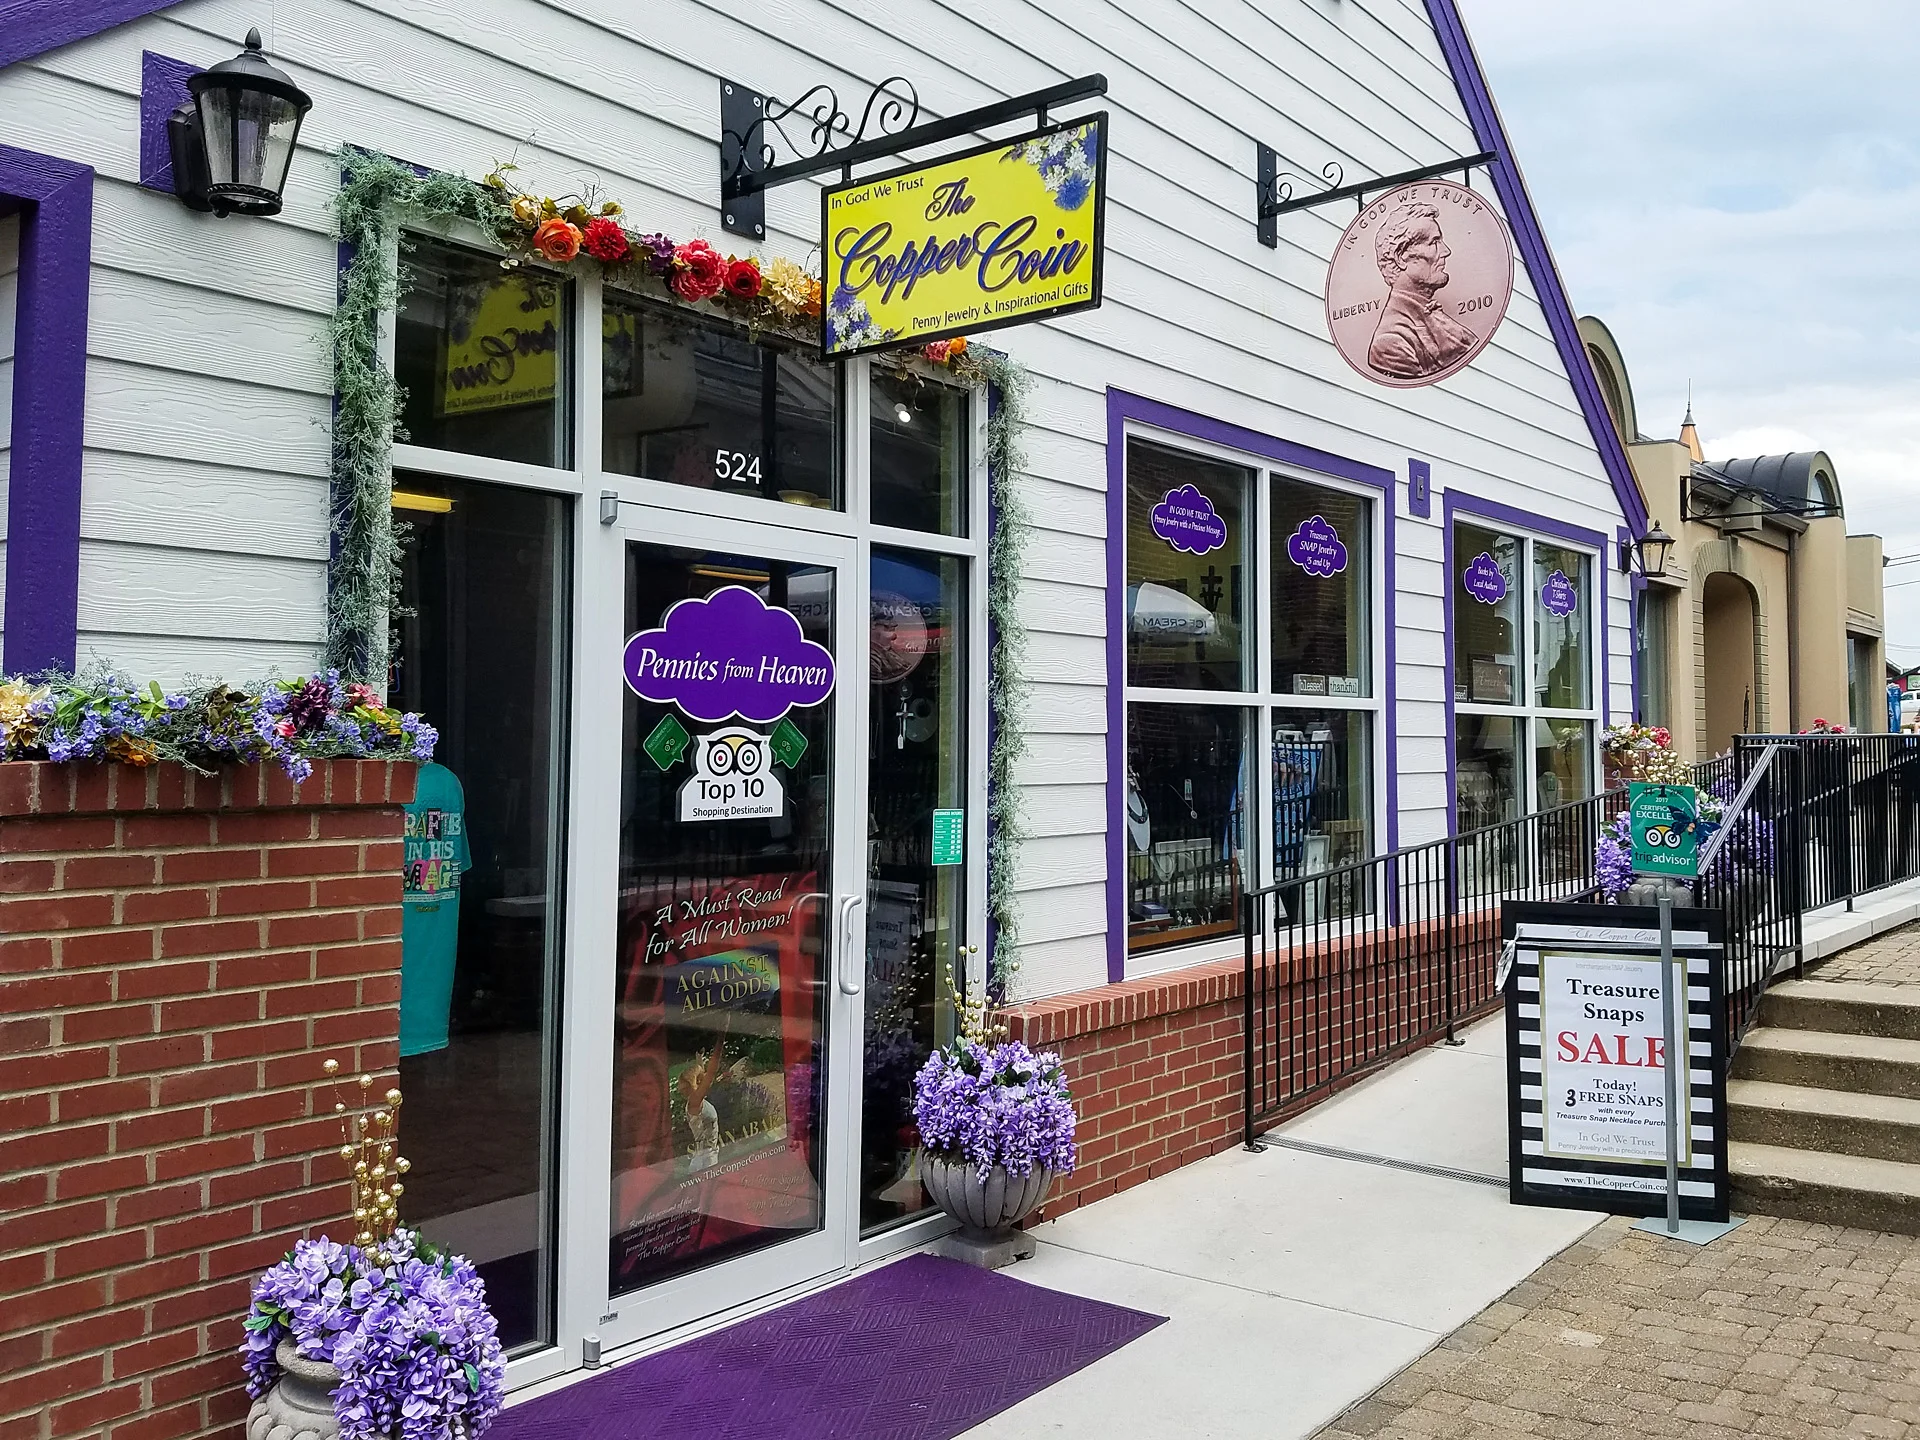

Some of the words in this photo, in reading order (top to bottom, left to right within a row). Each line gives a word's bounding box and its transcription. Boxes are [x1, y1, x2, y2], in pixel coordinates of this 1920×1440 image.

[831, 197, 842, 209] In
[845, 190, 870, 206] God
[873, 185, 892, 198] We
[896, 177, 924, 192] Trust
[925, 176, 976, 221] The
[1343, 234, 1358, 250] IN
[1360, 202, 1387, 229] GOD
[1397, 187, 1418, 203] WE
[1431, 187, 1483, 215] TRUST
[834, 221, 975, 305] Copper
[972, 215, 1088, 293] Coin
[912, 315, 942, 330] Penny
[944, 305, 980, 327] Jewelry
[983, 302, 993, 314] &
[995, 290, 1060, 313] Inspirational
[1063, 283, 1089, 298] Gifts
[1332, 299, 1381, 320] LIBERTY
[1457, 294, 1493, 315] 2010
[715, 449, 762, 485] 524
[1176, 506, 1186, 516] GOD
[1187, 508, 1194, 518] WE
[1195, 510, 1210, 521] TRUST
[1309, 530, 1328, 541] Treasure
[1300, 541, 1318, 551] SNAP
[1318, 544, 1337, 559] Jewelry
[1313, 558, 1321, 566] and
[1323, 559, 1331, 570] Up
[1474, 579, 1483, 588] Local
[637, 648, 719, 681] Pennies
[722, 658, 754, 683] from
[757, 656, 827, 686] Heaven
[1330, 681, 1357, 694] thankful
[697, 779, 736, 804] Top
[742, 778, 765, 798] 10
[693, 807, 730, 818] Shopping
[730, 804, 773, 816] Destination
[1636, 811, 1674, 820] EXCELLE
[1640, 804, 1670, 812] CERTIFICA
[408, 842, 423, 861] IN
[429, 841, 455, 861] HIS
[1635, 852, 1691, 866] tripadvisor
[654, 903, 672, 926] A
[681, 893, 732, 920] Must
[736, 877, 788, 908] Read
[645, 933, 674, 963] for
[680, 919, 713, 949] All
[715, 906, 793, 940] Women!
[1568, 927, 1592, 938] The
[1598, 929, 1628, 941] Copper
[1634, 930, 1657, 942] Coin
[675, 954, 769, 994] AGAINST
[681, 992, 716, 1014] ALL
[719, 974, 771, 1003] ODDS
[1566, 978, 1660, 1000] Treasure
[1584, 1002, 1645, 1027] Snaps
[1557, 1031, 1666, 1069] SALE
[1593, 1078, 1637, 1095] Today!
[1565, 1089, 1577, 1107] 3
[1579, 1091, 1615, 1103] FREE
[1618, 1094, 1664, 1108] SNAPS
[1556, 1112, 1587, 1121] Treasure
[1589, 1114, 1608, 1123] Snap
[1609, 1116, 1642, 1125] Necklace
[1644, 1119, 1667, 1127] Purch
[1598, 1107, 1613, 1115] with
[1615, 1109, 1636, 1117] every
[1558, 1142, 1577, 1151] Penny
[1579, 1144, 1601, 1152] Jewelry
[1621, 1147, 1647, 1155] precious
[1579, 1132, 1588, 1141] In
[1591, 1133, 1610, 1143] God
[1613, 1135, 1628, 1144] We
[1630, 1136, 1655, 1147] Trust
[680, 1145, 786, 1189] www.TheCopperCoin.com
[638, 1249, 651, 1260] The
[652, 1240, 675, 1256] Copper
[676, 1234, 691, 1245] Coin
